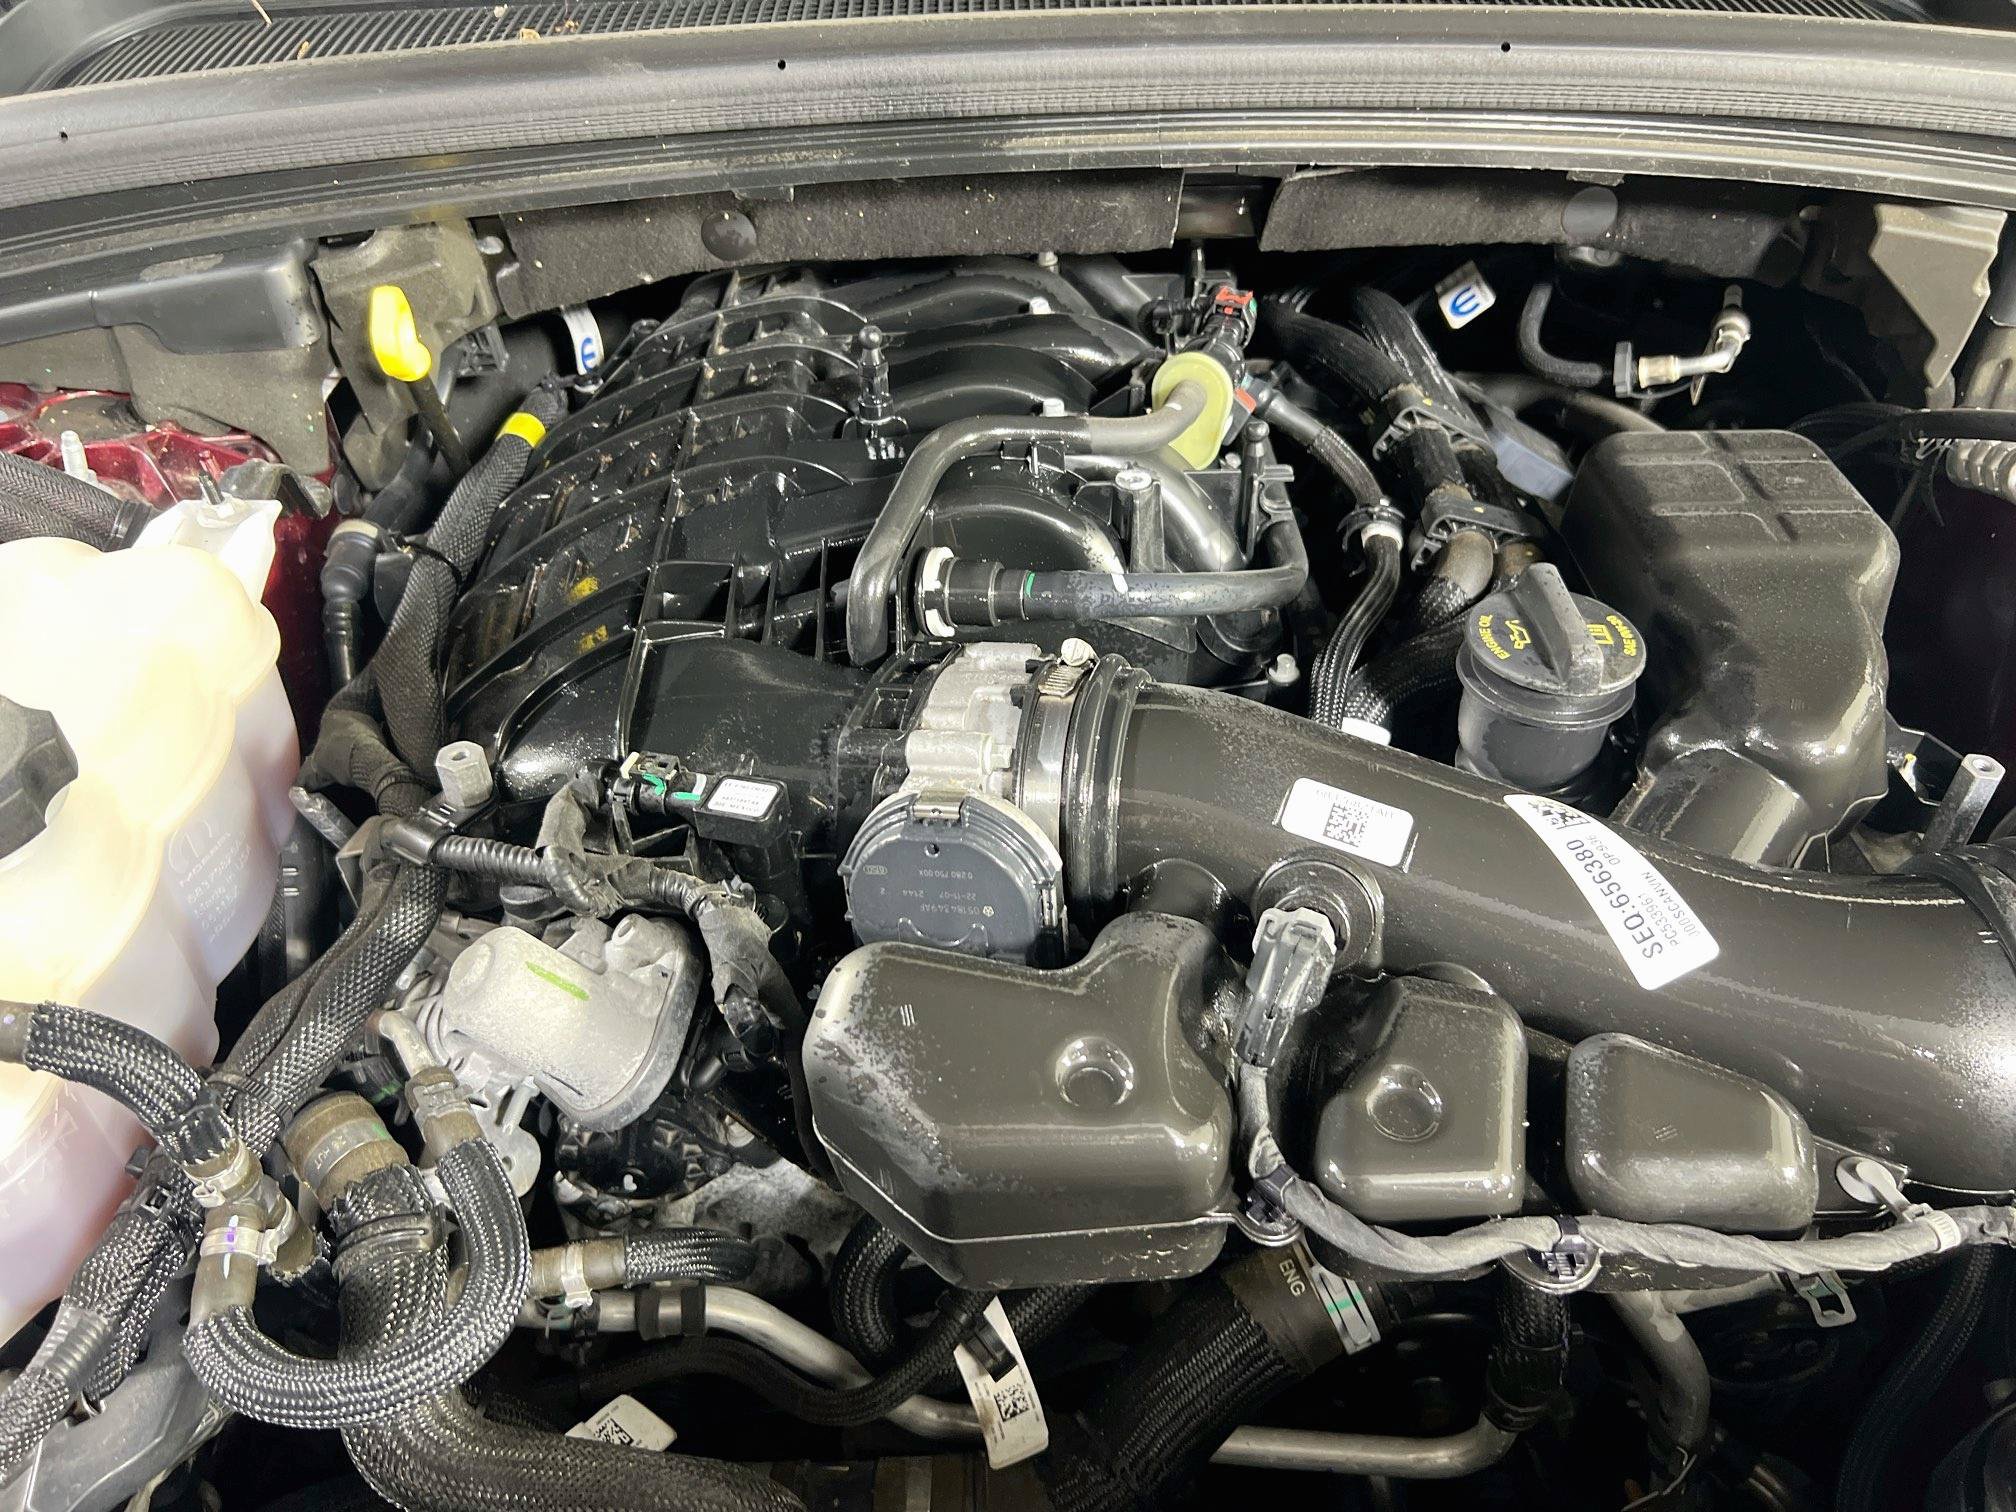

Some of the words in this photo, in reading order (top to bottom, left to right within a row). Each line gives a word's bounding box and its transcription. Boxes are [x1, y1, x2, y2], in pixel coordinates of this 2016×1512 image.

[1478, 614, 1493, 628] OIL
[1479, 628, 1511, 660] ENGINE
[1622, 638, 1637, 657] SAE
[1566, 839, 1663, 958] SEQ:656380
[1280, 1259, 1306, 1297] ENG
